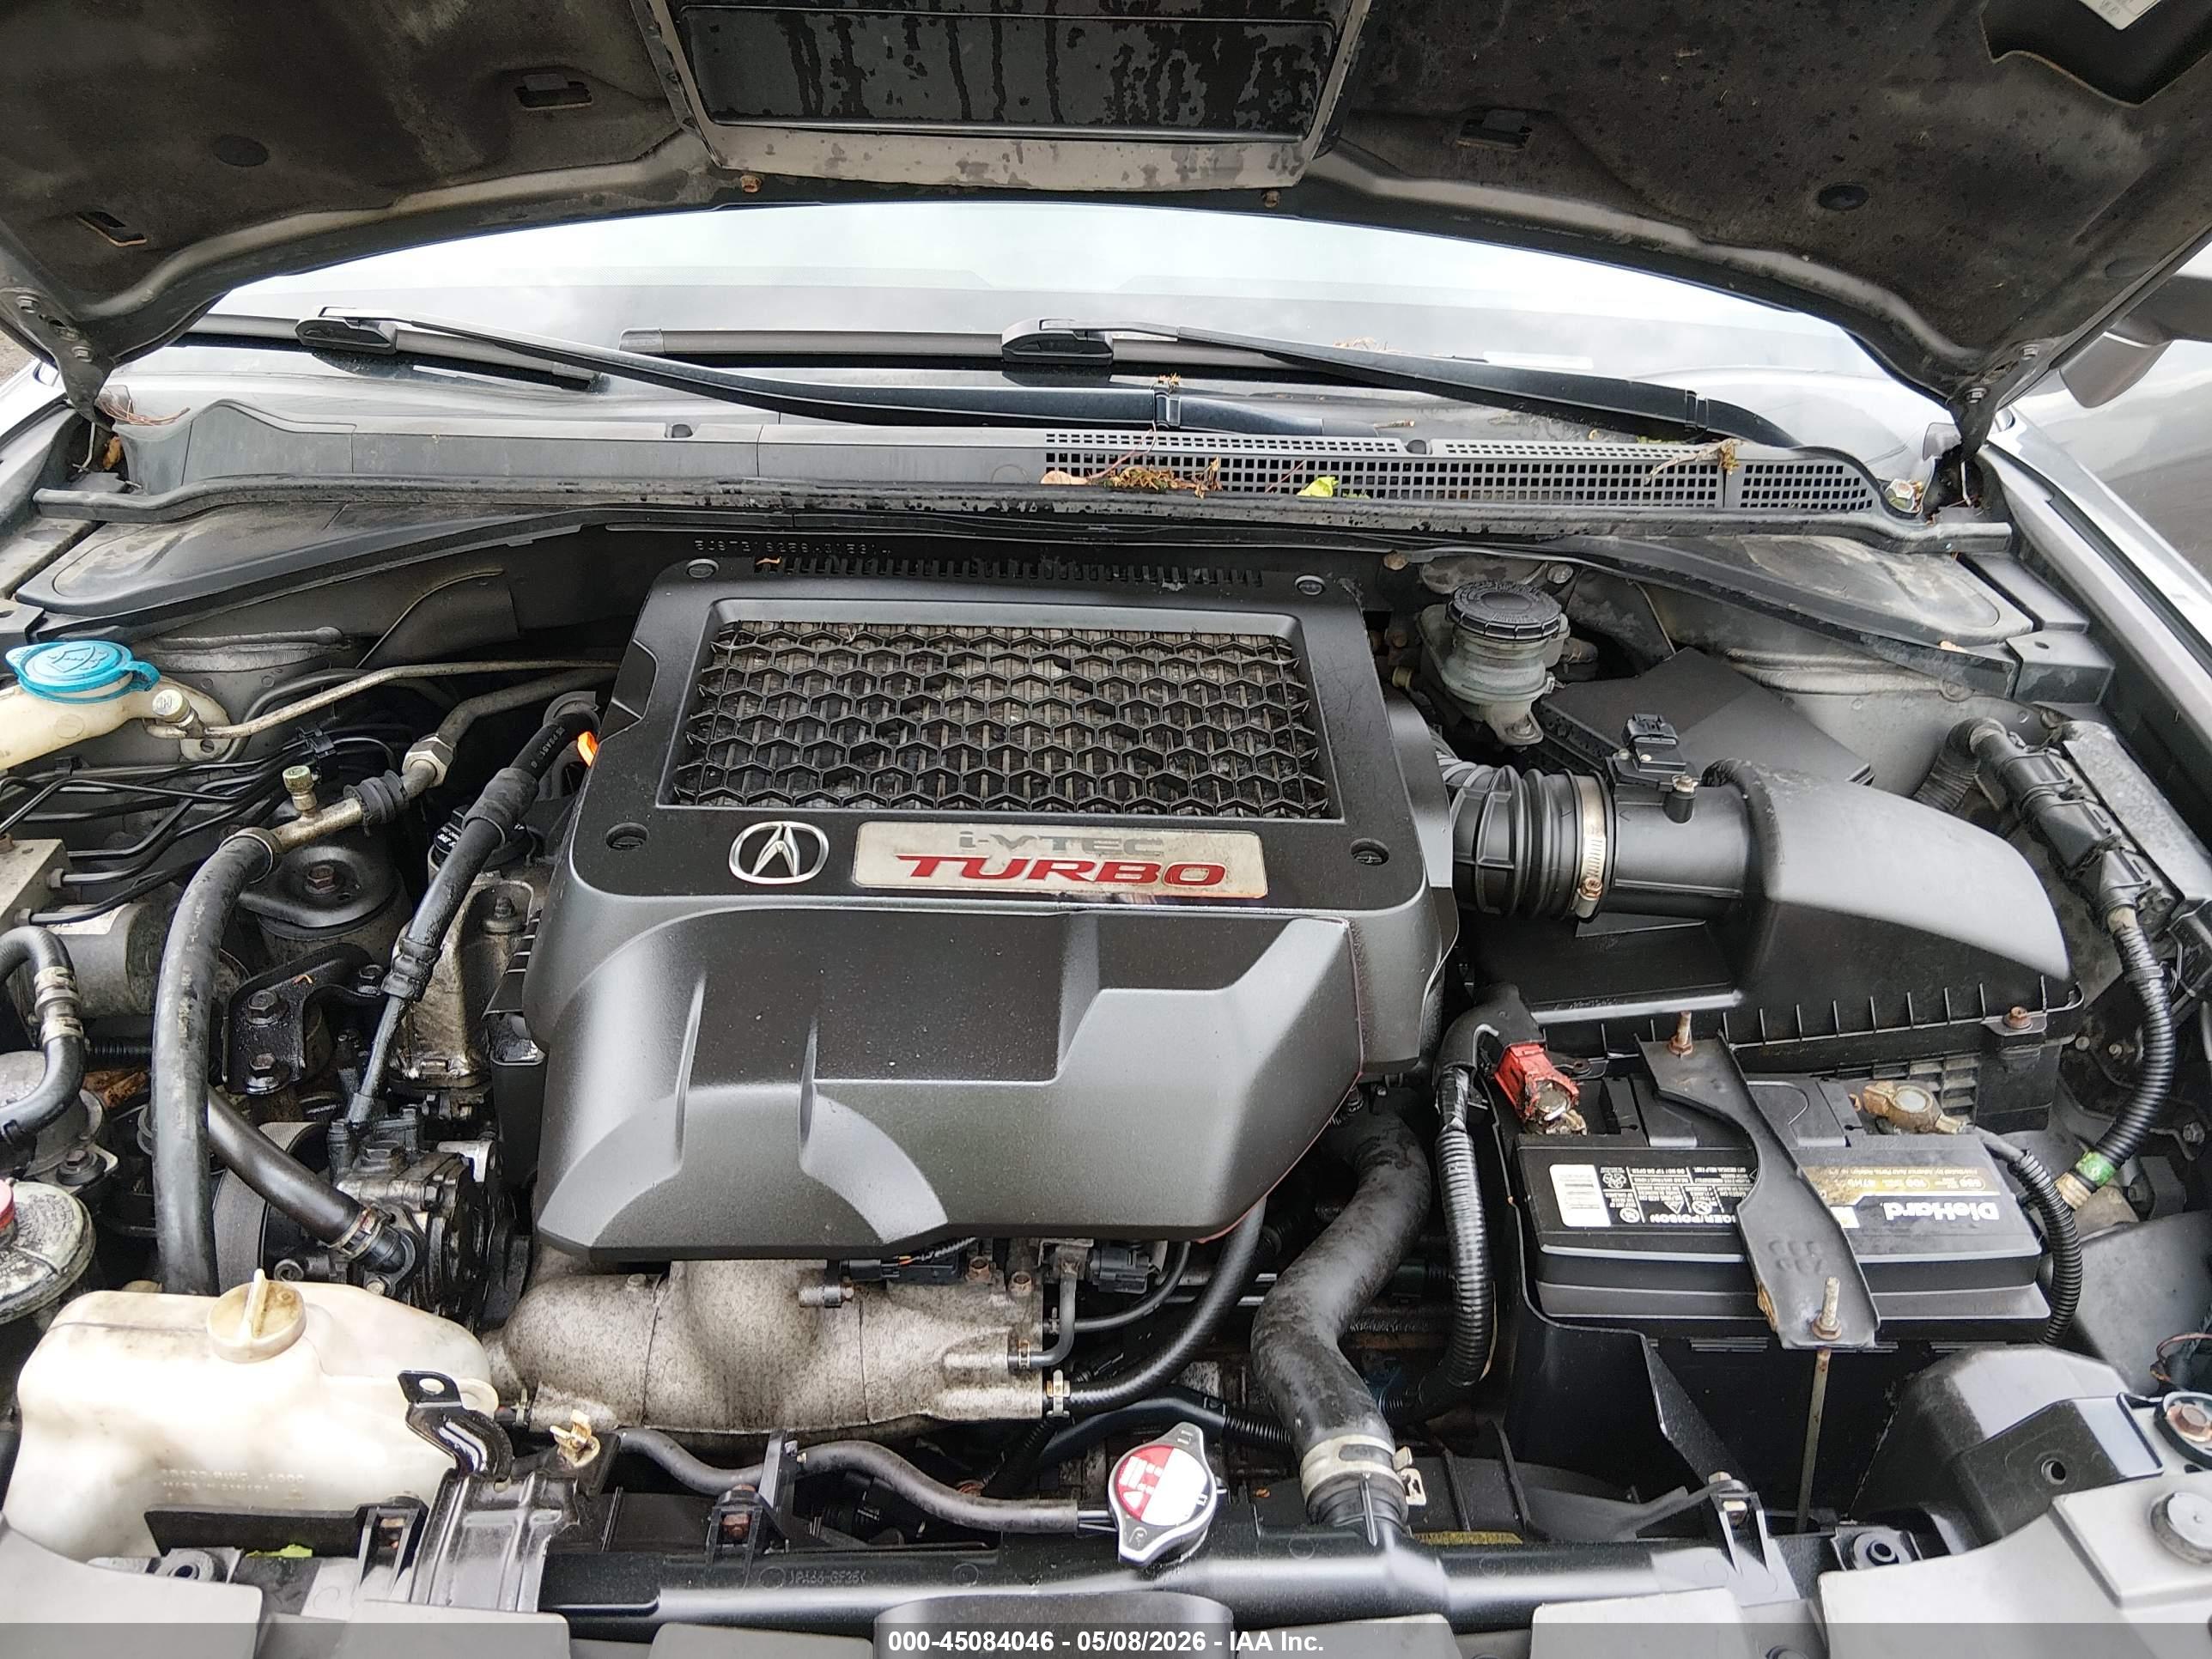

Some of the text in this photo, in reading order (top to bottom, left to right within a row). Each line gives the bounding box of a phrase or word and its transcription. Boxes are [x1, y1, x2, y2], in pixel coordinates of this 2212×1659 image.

[960, 830, 1164, 857] i-VTEC
[896, 855, 1228, 887] TURBO
[1883, 1202, 2000, 1220] DieHard
